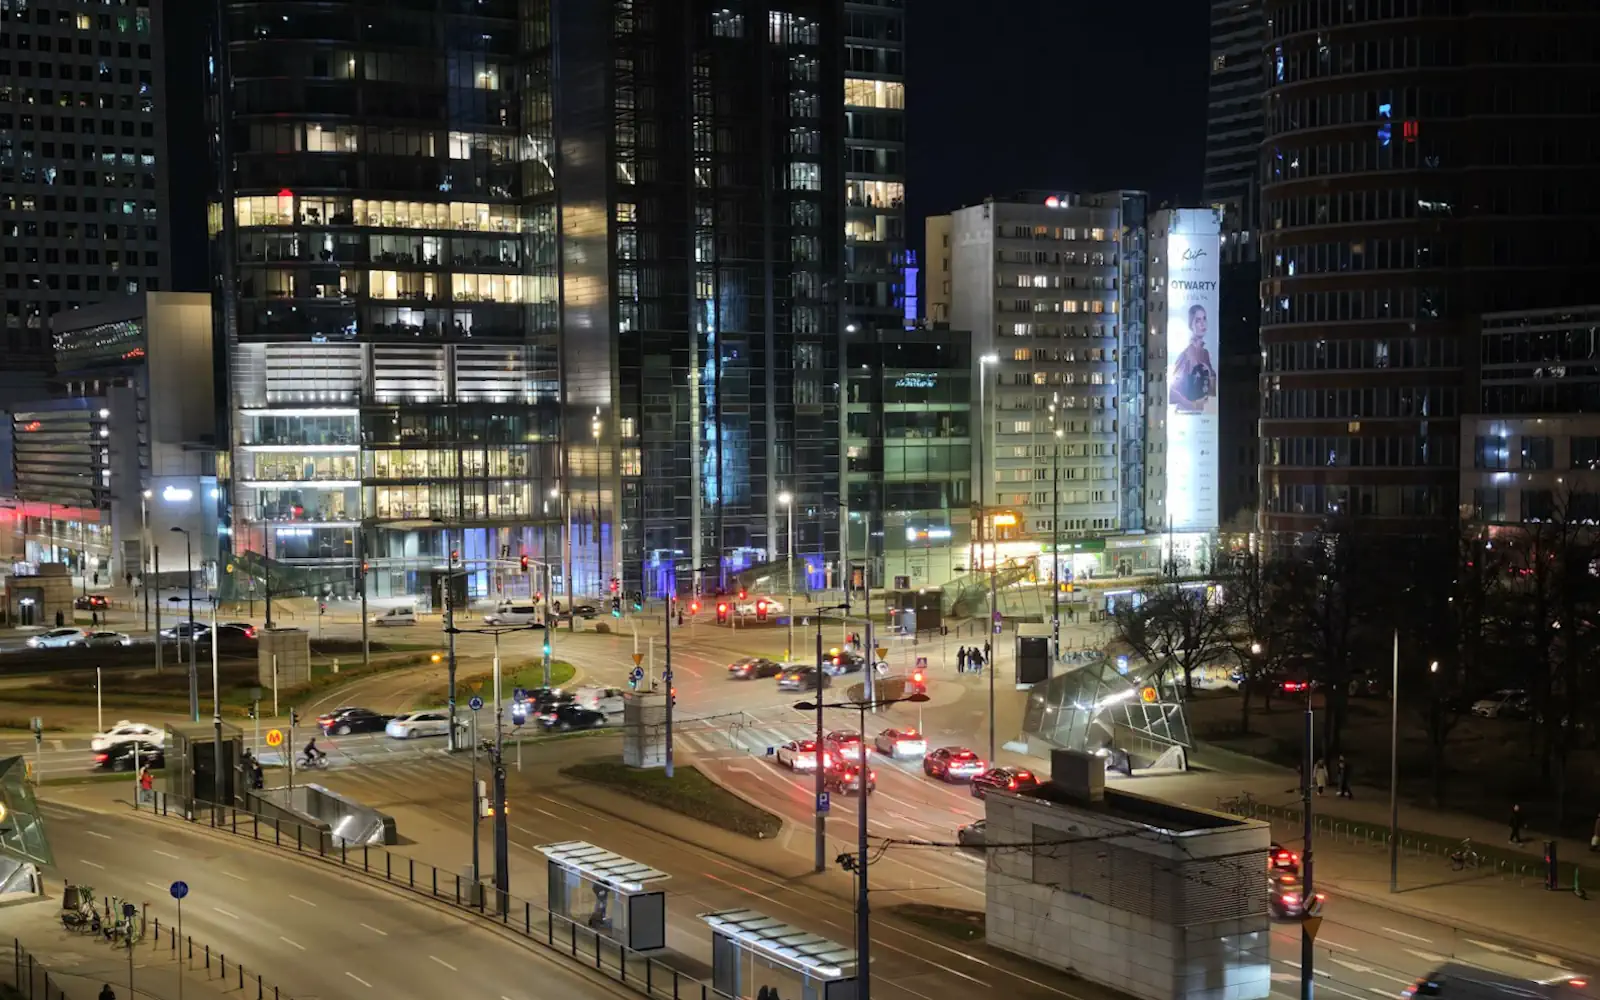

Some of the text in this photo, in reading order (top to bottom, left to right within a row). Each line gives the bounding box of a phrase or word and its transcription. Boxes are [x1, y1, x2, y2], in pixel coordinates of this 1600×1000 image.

[1171, 280, 1217, 291] OTWARTY
[268, 732, 281, 744] M
[819, 793, 828, 805] P
